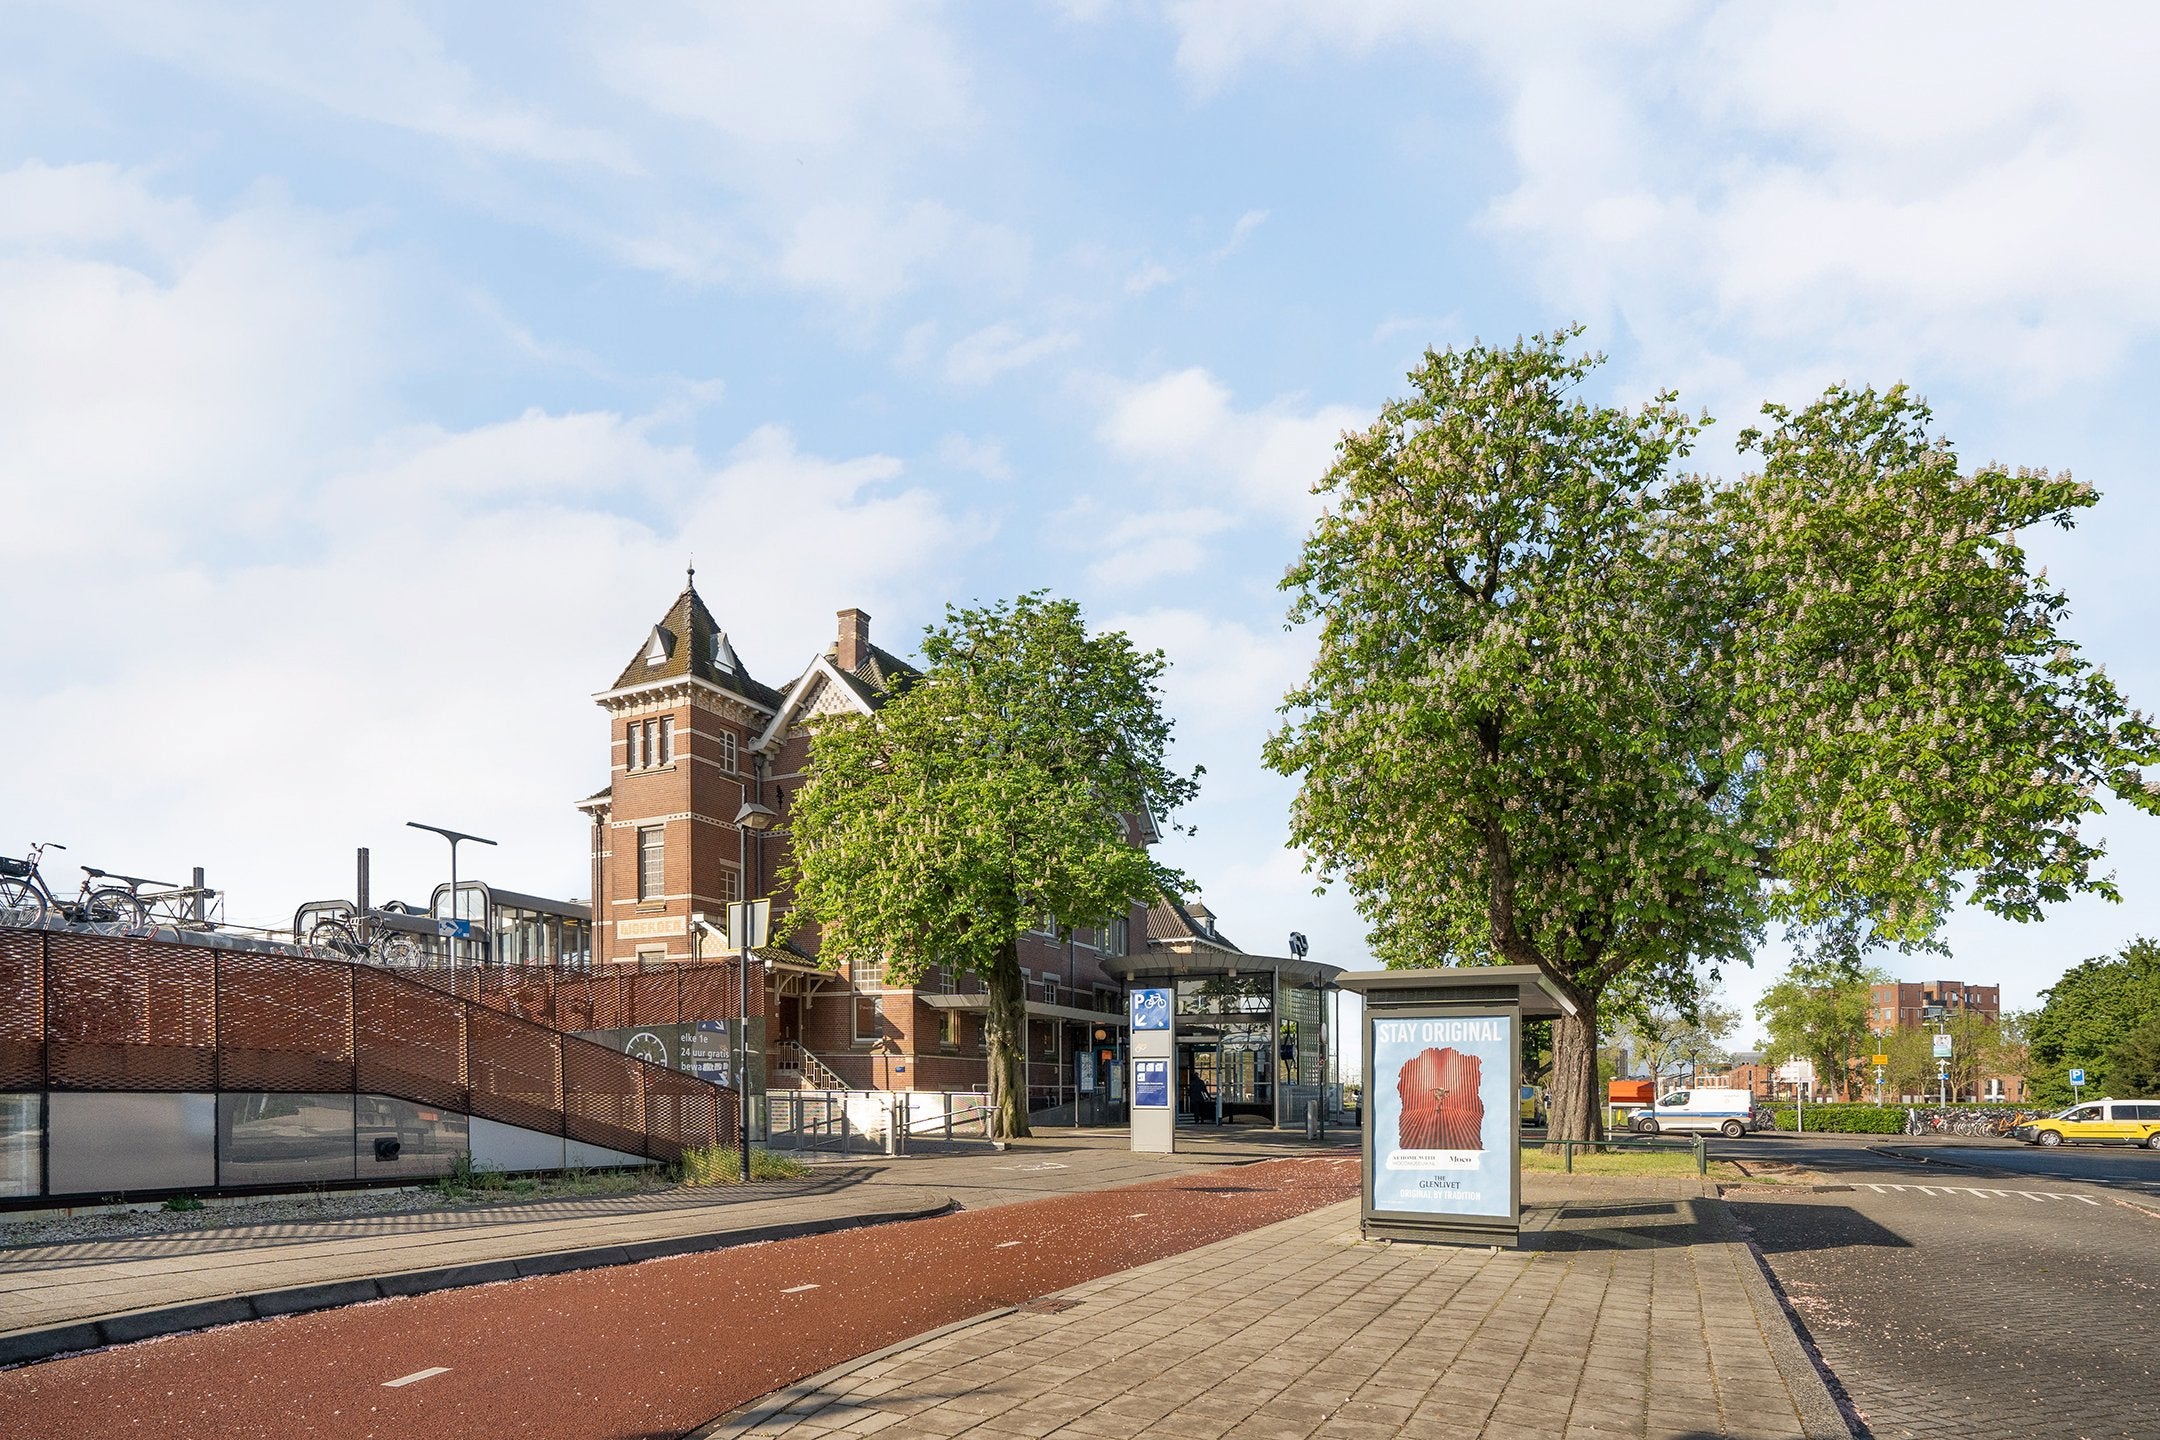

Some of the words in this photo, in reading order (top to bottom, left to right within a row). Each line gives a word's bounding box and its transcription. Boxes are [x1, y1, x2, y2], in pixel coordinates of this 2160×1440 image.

[1134, 993, 1145, 1010] P
[680, 1033, 697, 1043] elke
[699, 1034, 709, 1043] 1e
[1379, 1022, 1418, 1043] STAY
[1422, 1021, 1503, 1042] ORIGINAL
[680, 1047, 691, 1057] 24
[692, 1049, 706, 1057] uur
[707, 1049, 730, 1060] gratis
[2072, 1070, 2081, 1079] P
[1419, 1180, 1461, 1189] GLENLIVET
[1400, 1188, 1432, 1199] ORIGINAL
[1433, 1190, 1443, 1199] BY
[1444, 1191, 1481, 1200] TRADITION
